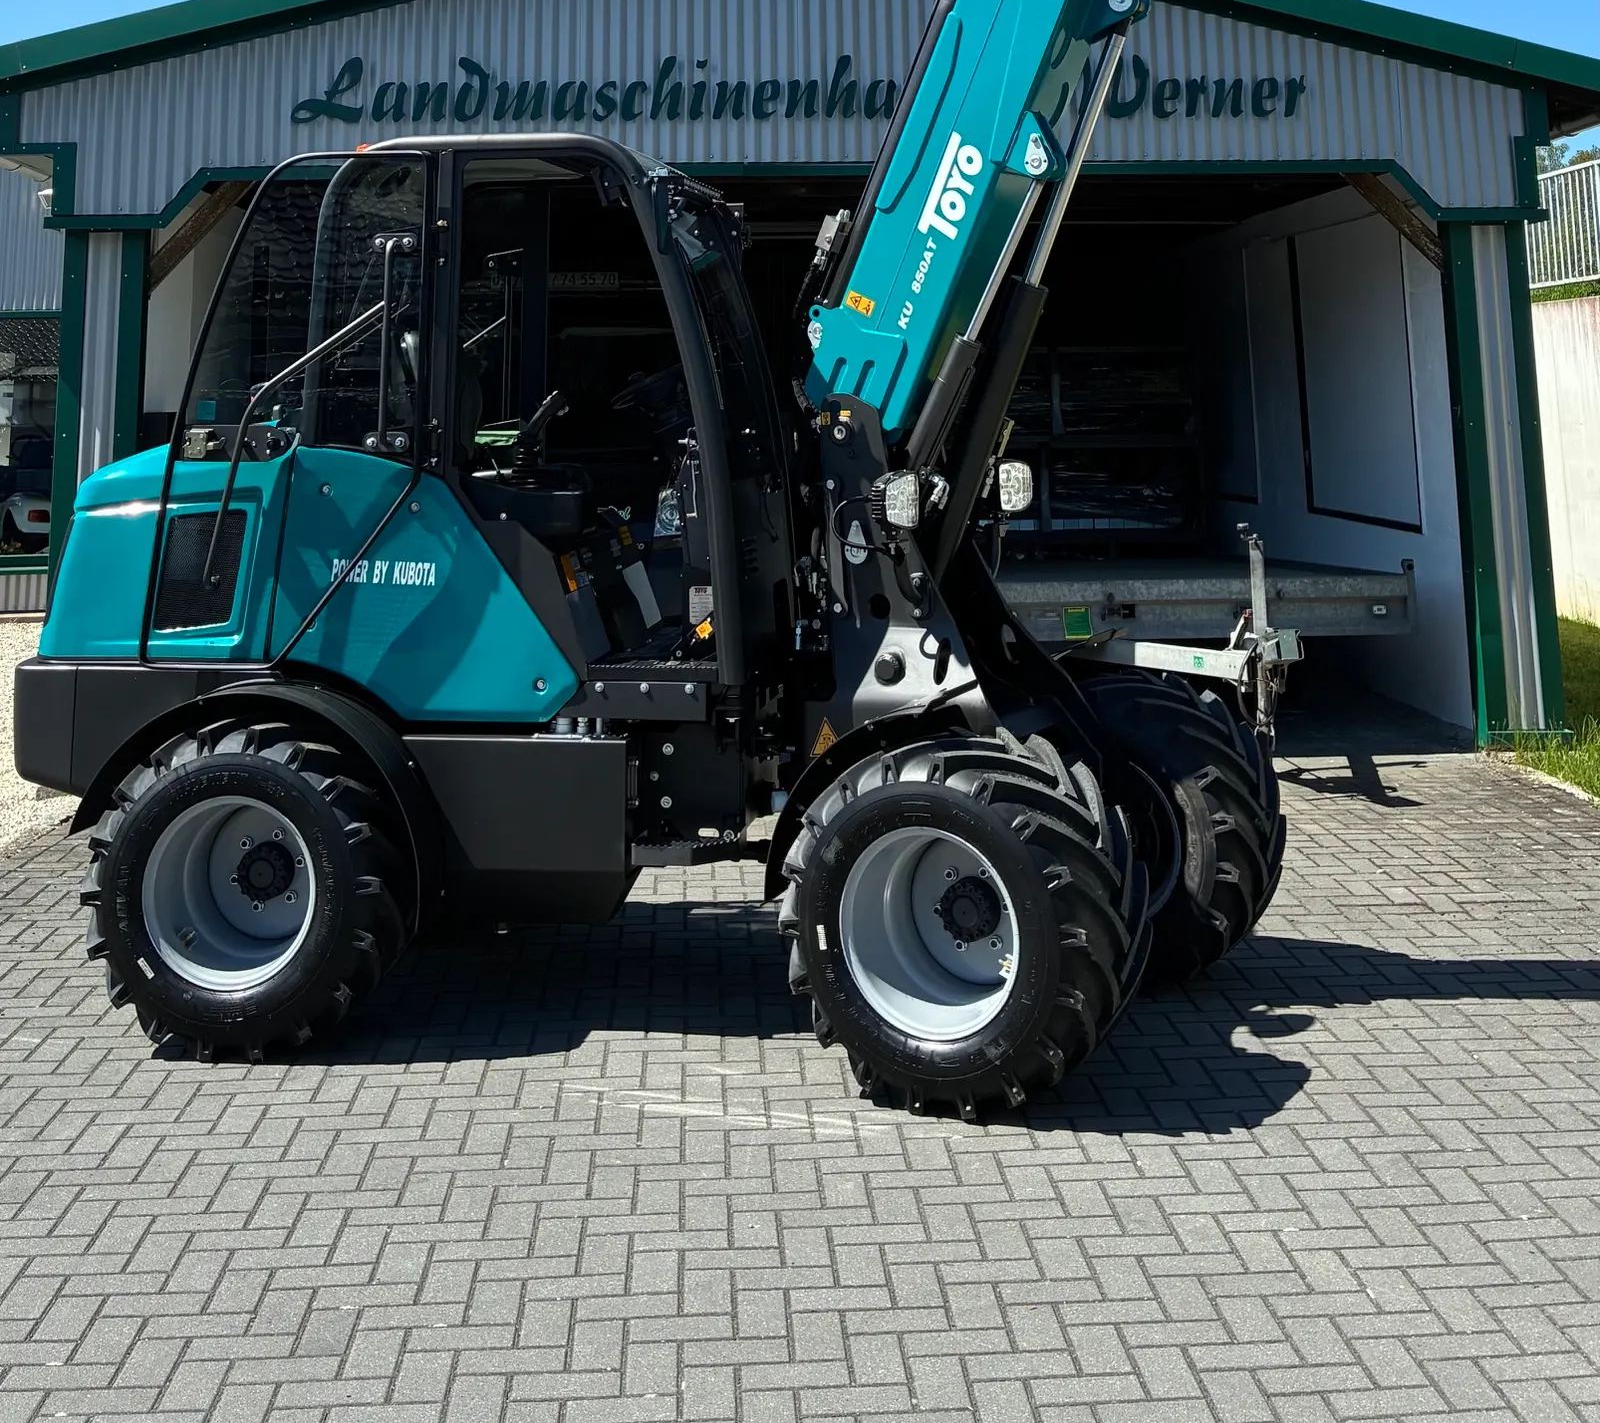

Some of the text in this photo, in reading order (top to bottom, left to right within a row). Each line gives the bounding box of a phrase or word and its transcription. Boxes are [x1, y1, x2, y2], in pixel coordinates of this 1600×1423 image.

[291, 55, 899, 123] Landmaschinenha
[917, 130, 983, 241] TOYO
[580, 273, 596, 286] 55
[600, 273, 616, 286] 70
[897, 236, 938, 330] KU 850AT
[372, 560, 390, 584] BY
[392, 561, 436, 587] KUBOTA
